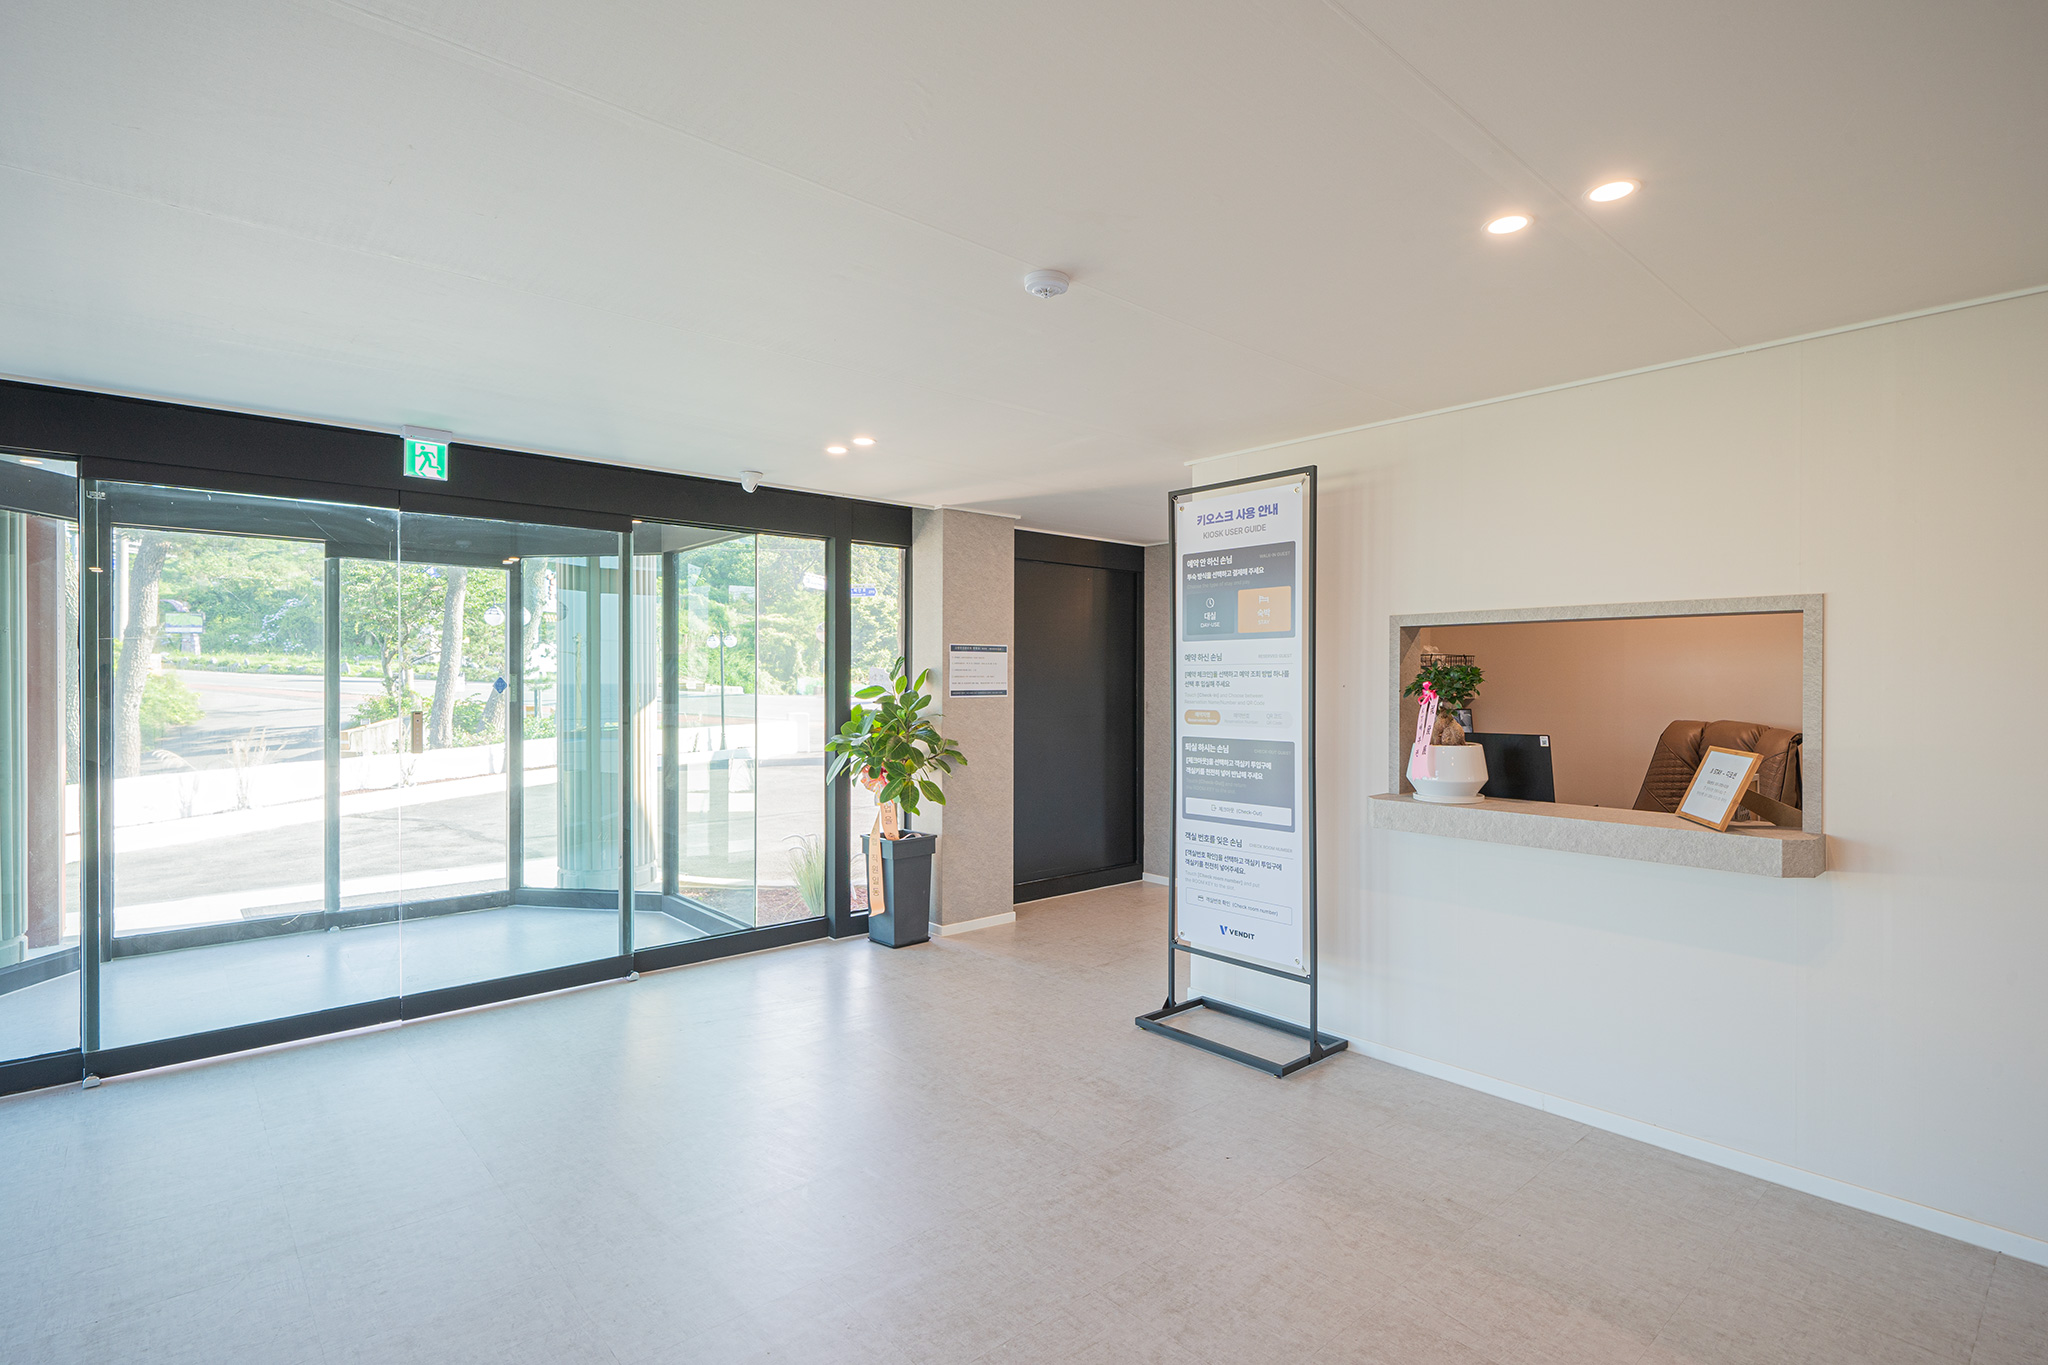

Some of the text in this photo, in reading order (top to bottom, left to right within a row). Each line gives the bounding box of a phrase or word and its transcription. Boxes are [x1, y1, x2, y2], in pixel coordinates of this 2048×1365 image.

[1197, 503, 1278, 526] 키오스크 사용 안내
[1203, 524, 1266, 539] KIOSK USER GUIDE
[1187, 555, 1233, 568] 예약 안 하신 손님
[1187, 573, 1196, 581] 투숙
[1212, 569, 1232, 579] 선택하고
[1249, 566, 1264, 575] 주세요
[1204, 612, 1216, 620] 대실
[1257, 609, 1270, 617] 숙박
[1184, 653, 1222, 662] 예약 하신 손님
[1185, 743, 1229, 754] 퇴실 하시는 손님
[1215, 758, 1234, 767] 선택하고
[1235, 759, 1250, 768] 객실키
[1251, 761, 1272, 770] 투입구에
[1186, 767, 1205, 776] 객실키를
[1248, 771, 1263, 780] 주세요
[1185, 832, 1242, 848] 객실 번호를 잊은 손님
[1185, 859, 1203, 867] 객실키를
[1224, 854, 1243, 865] 선택하고
[1245, 857, 1260, 868] 객실키
[1261, 860, 1282, 871] 투입구에
[1229, 928, 1255, 940] VENDIT
